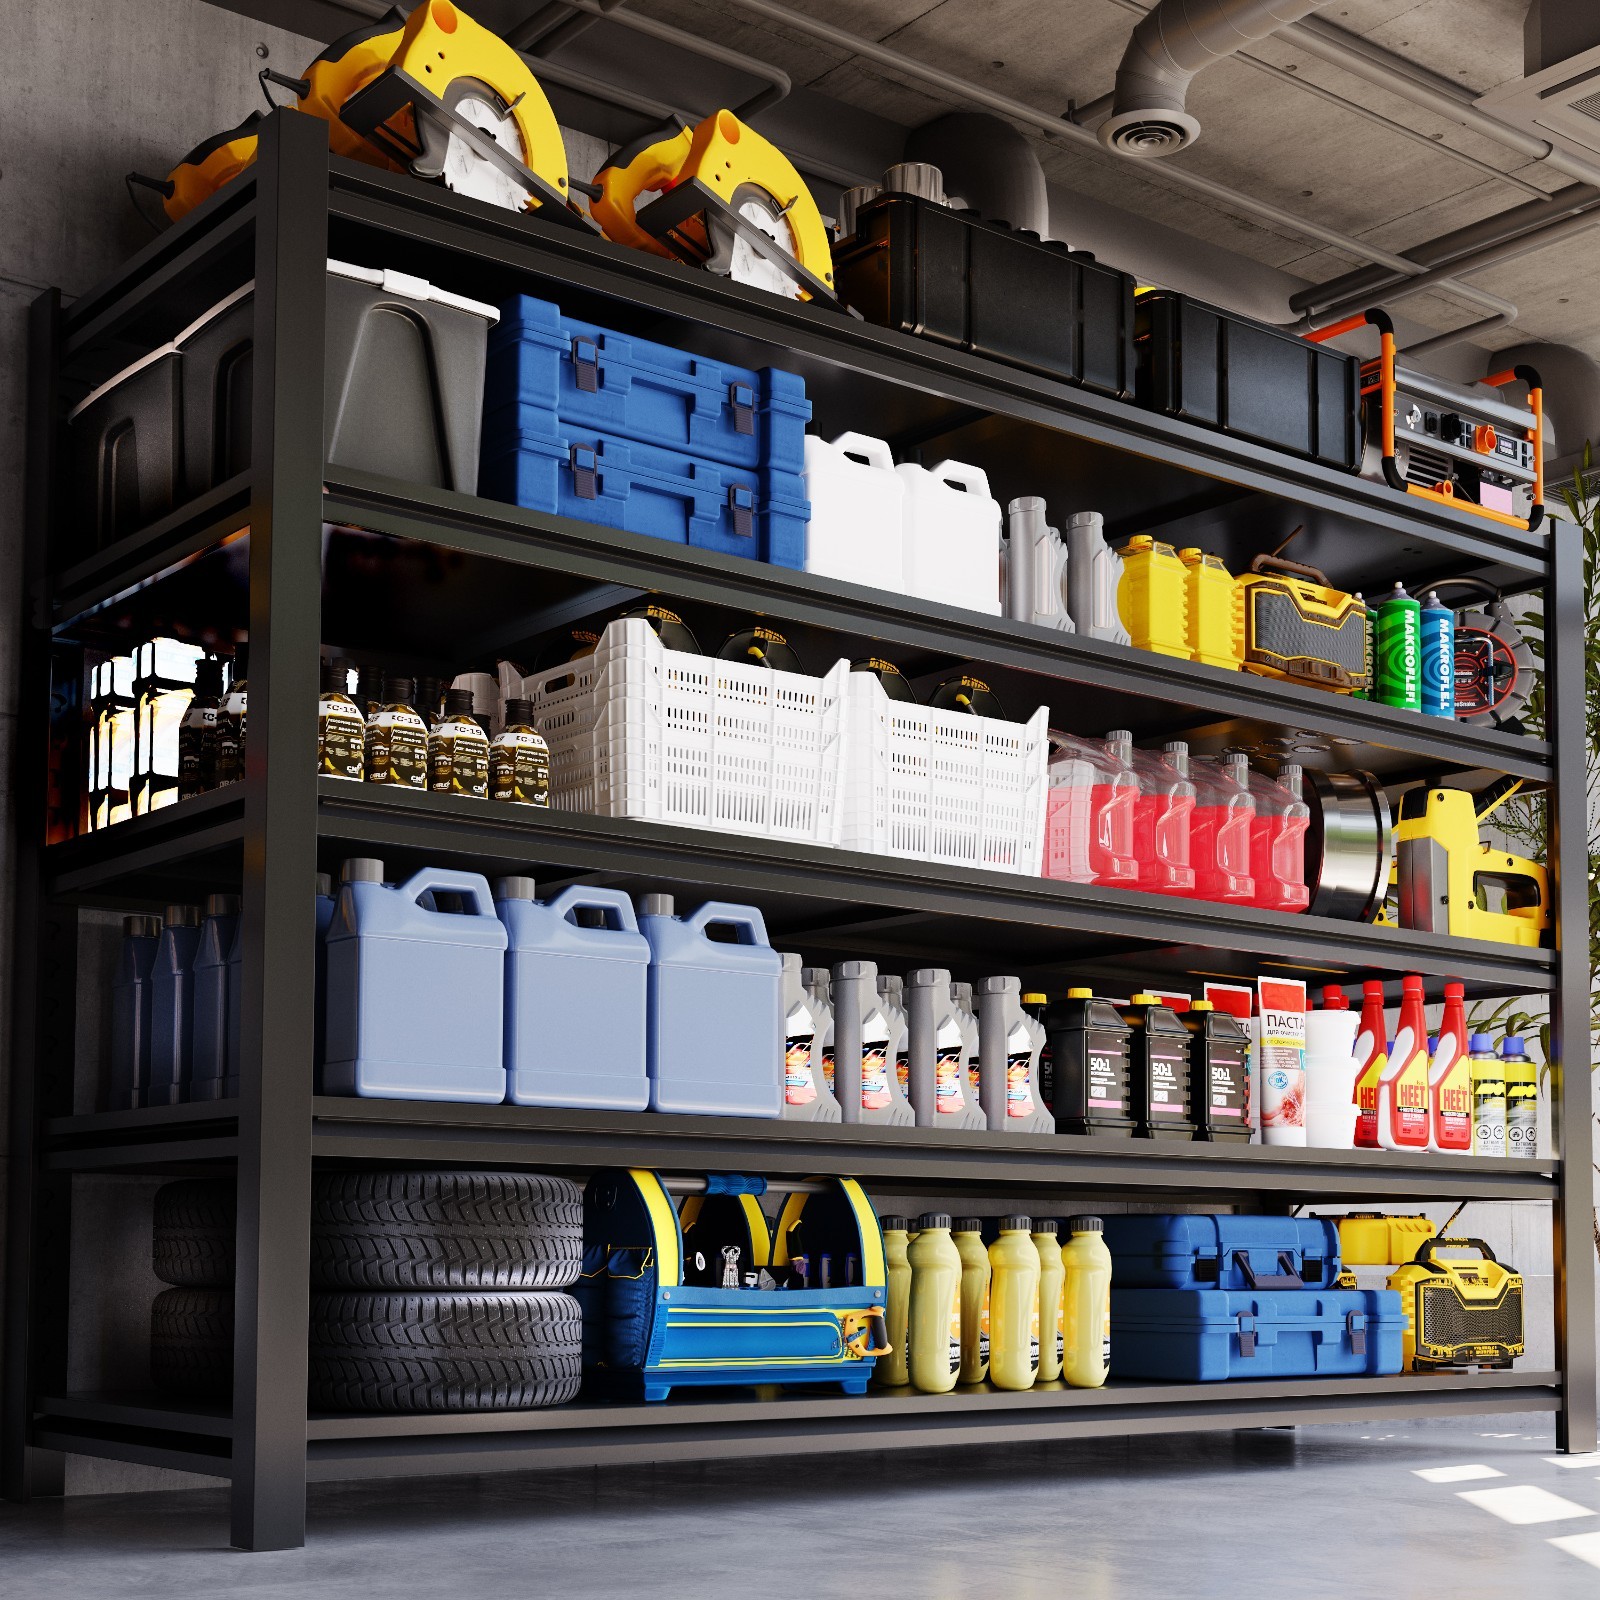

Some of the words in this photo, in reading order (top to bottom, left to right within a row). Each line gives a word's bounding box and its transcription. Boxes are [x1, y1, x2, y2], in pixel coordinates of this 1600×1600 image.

[1266, 1014, 1305, 1030] ПАСТА
[1400, 1084, 1425, 1107] HEET
[1443, 1089, 1468, 1111] HEET
